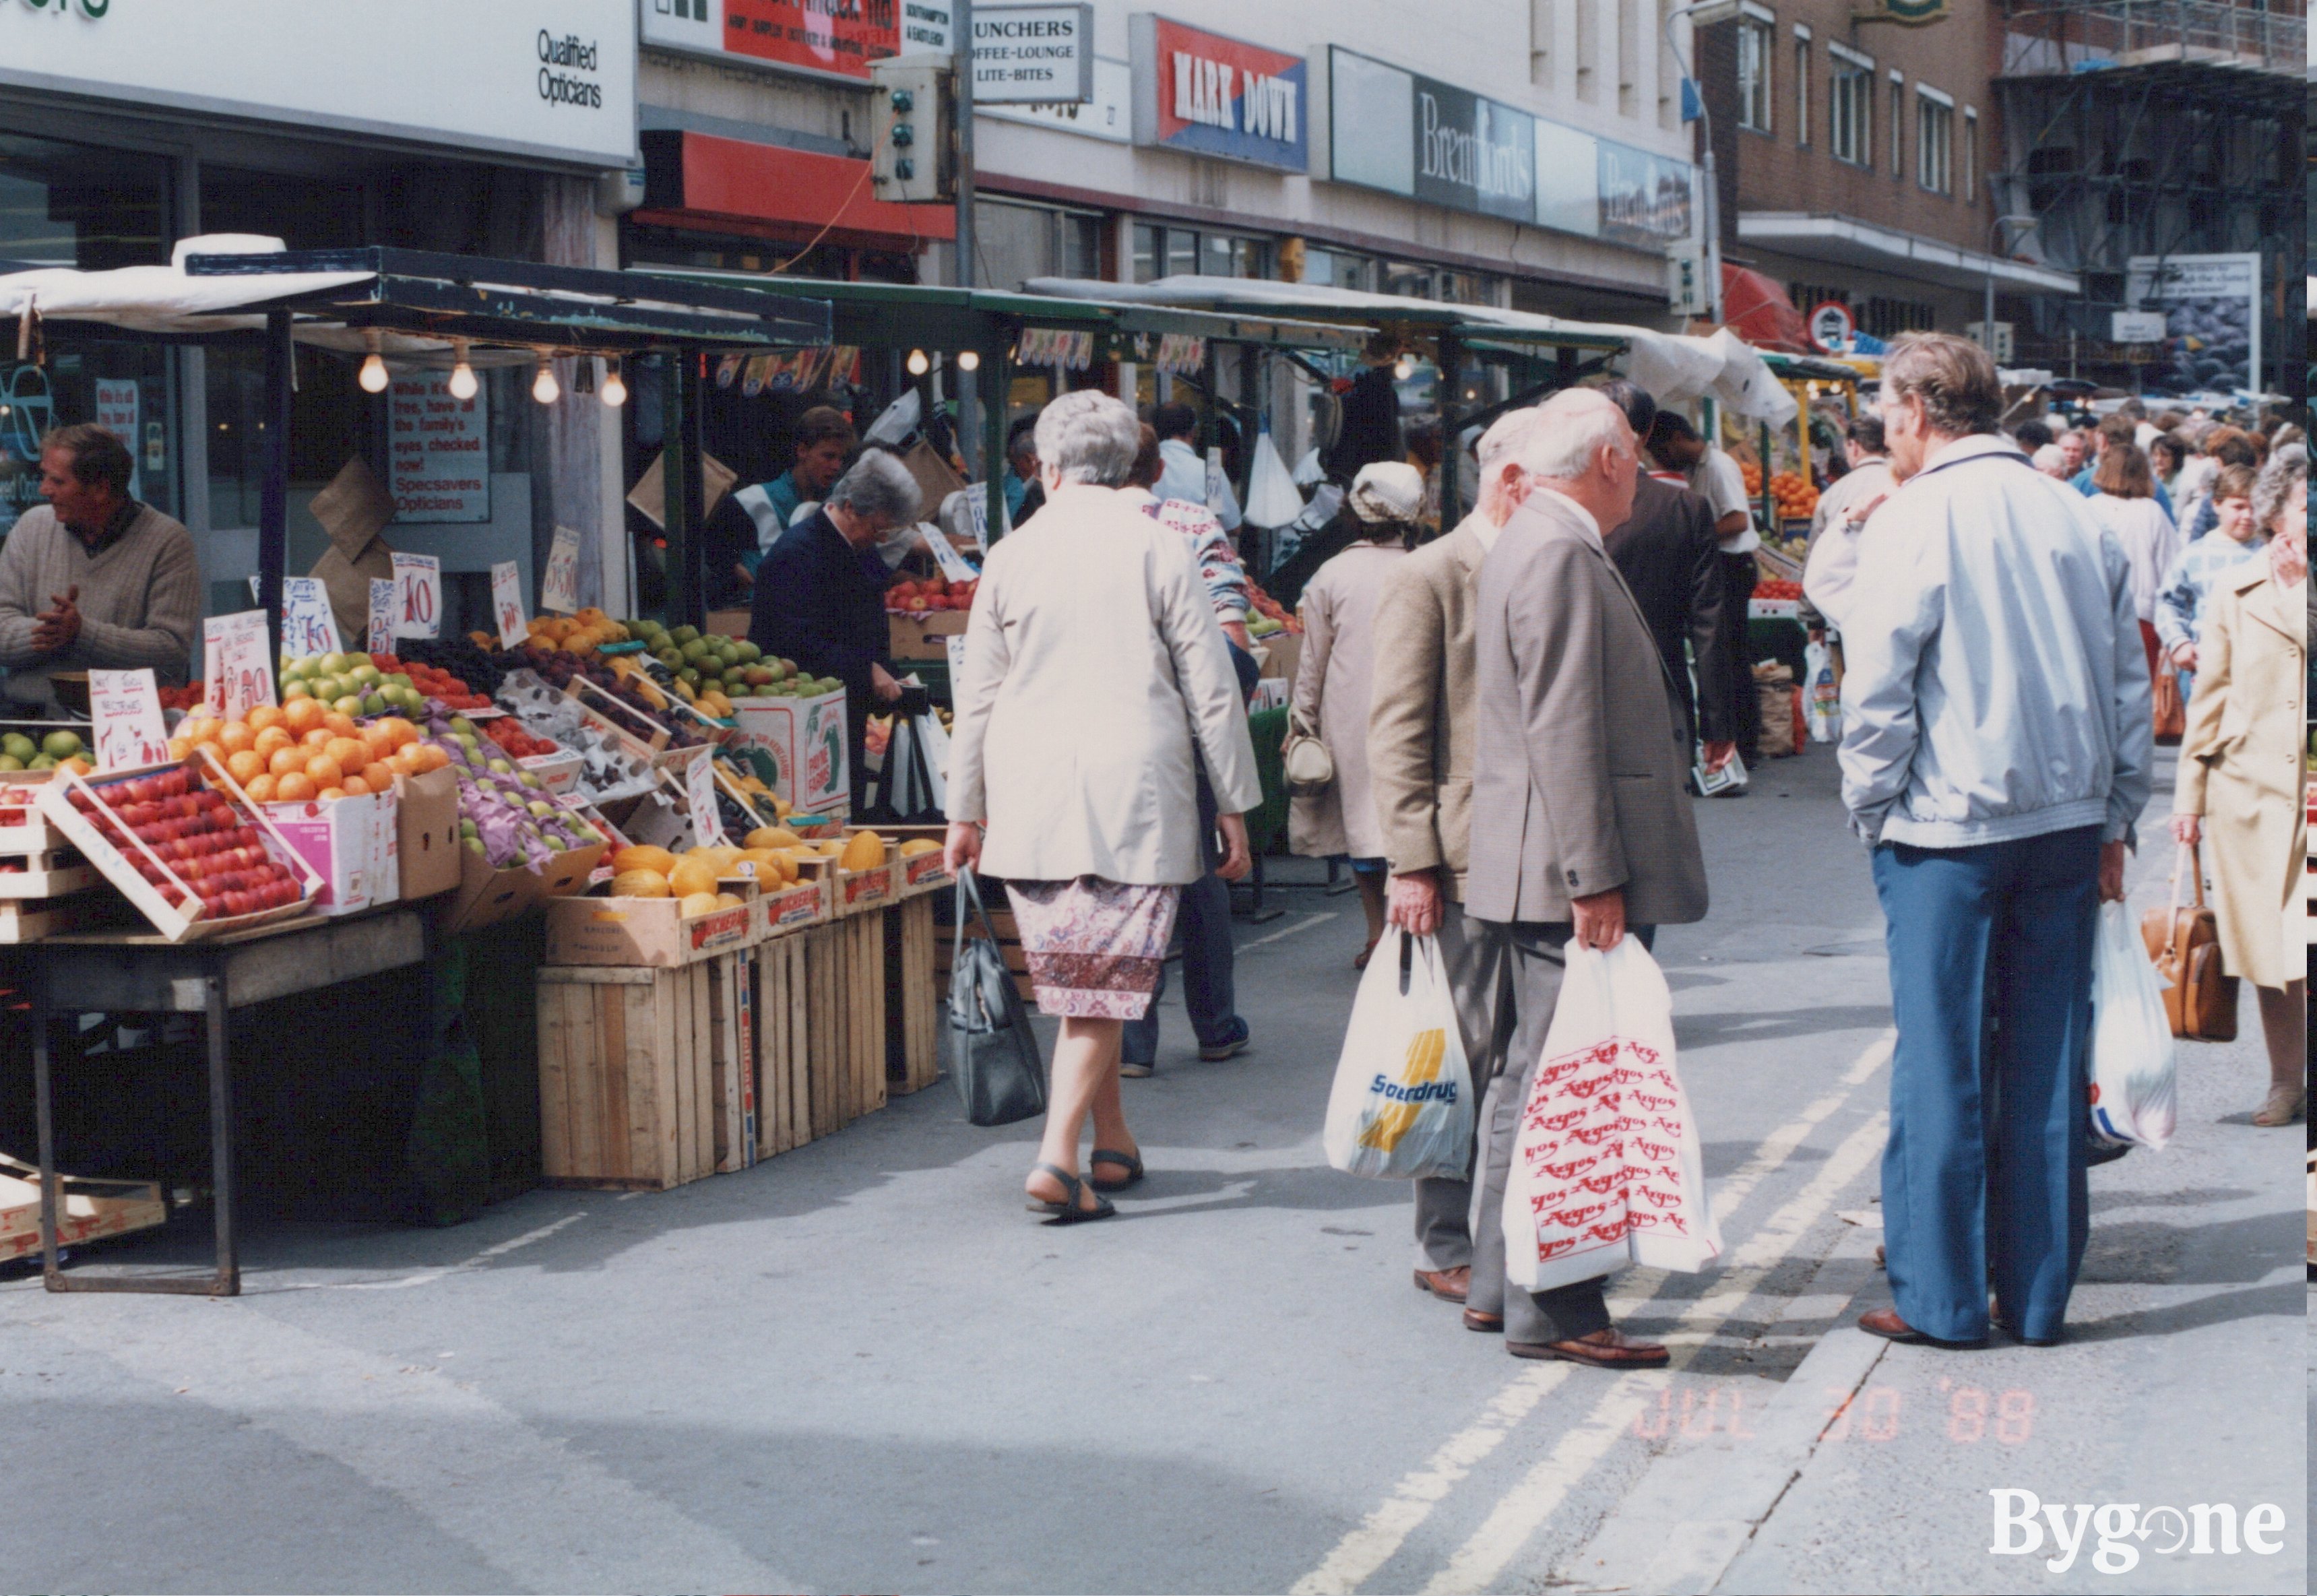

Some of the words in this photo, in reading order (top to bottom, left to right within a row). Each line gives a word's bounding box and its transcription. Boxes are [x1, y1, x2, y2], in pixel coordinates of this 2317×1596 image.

[906, 3, 949, 25] SOUTHAMPTON
[974, 21, 1073, 38] UNCHERS
[538, 29, 597, 71] Qualified
[972, 45, 1074, 60] FFEE-LOUNGE
[978, 68, 1053, 82] LITE-BITES
[539, 67, 602, 109] Opticians
[1174, 51, 1234, 130] MARK
[1243, 69, 1296, 144] DOWN
[1420, 92, 1532, 201] Brentfords
[395, 441, 423, 455] eyes
[429, 437, 480, 452] checked
[395, 476, 482, 494] Specsavers
[395, 496, 464, 513] Opticians
[808, 745, 829, 777] PAYNE
[808, 764, 830, 798] FARMS
[1627, 1089, 1677, 1112] Argos
[1528, 1106, 1588, 1132] Argos
[1629, 1137, 1676, 1161] Argos
[1533, 1155, 1599, 1181] Argos
[1635, 1184, 1682, 1209] Argos
[1540, 1201, 1608, 1228] Argos
